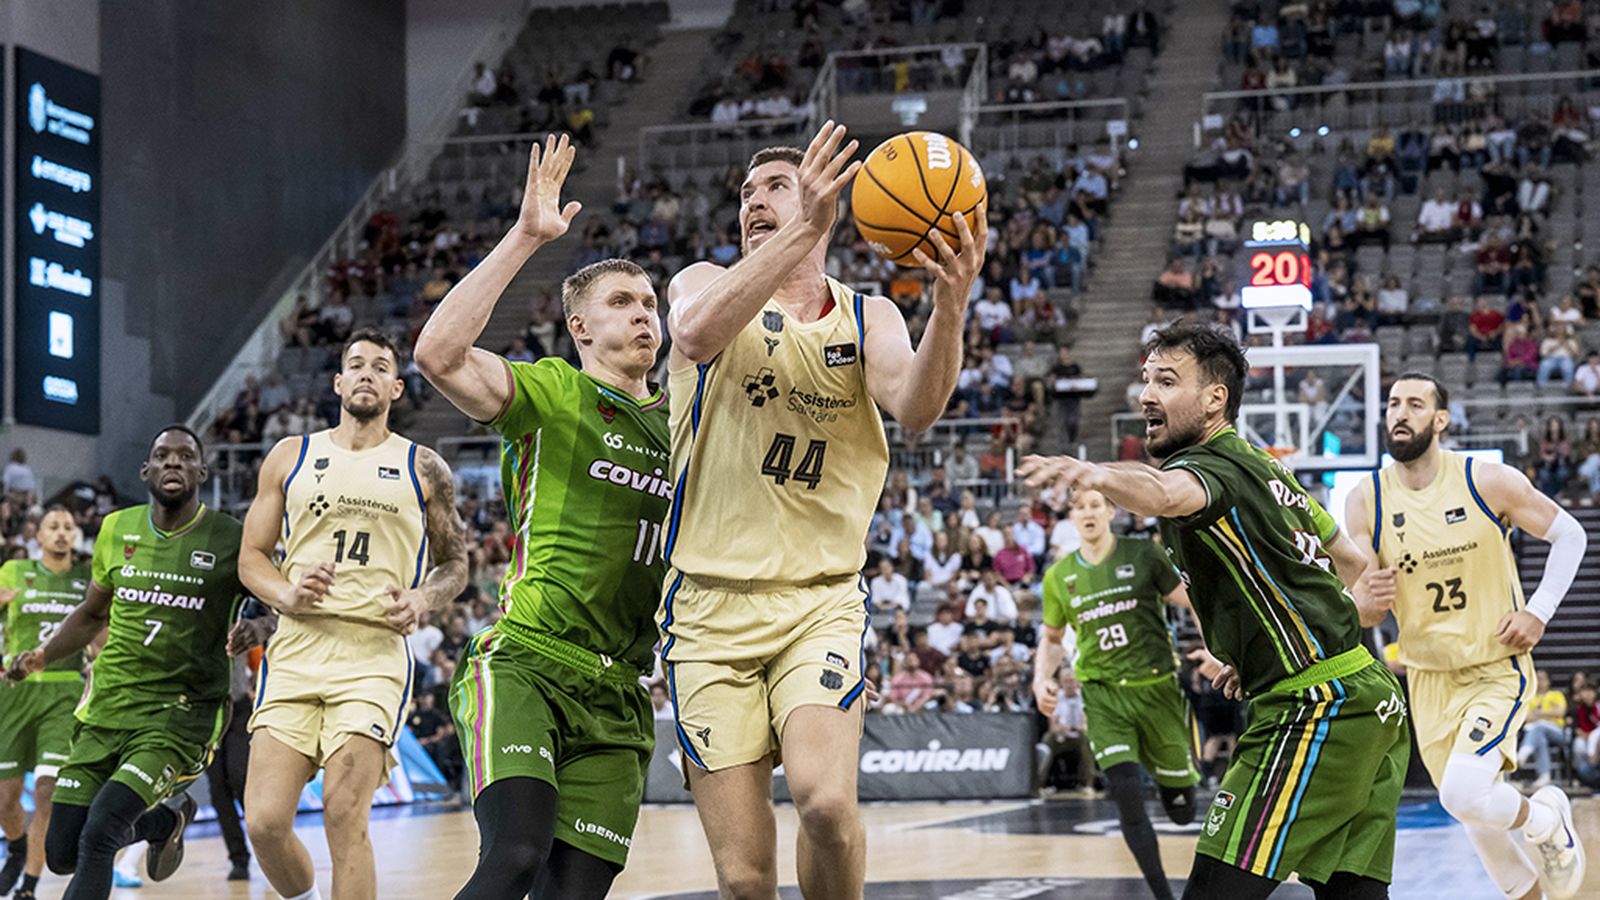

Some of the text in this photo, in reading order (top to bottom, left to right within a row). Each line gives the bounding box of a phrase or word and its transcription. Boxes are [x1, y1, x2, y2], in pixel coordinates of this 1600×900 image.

[1250, 251, 1299, 287] 20
[603, 432, 624, 449] 65
[761, 432, 827, 490] 44
[333, 530, 370, 566] 14
[633, 518, 660, 566] 11
[1425, 577, 1467, 613] 23
[143, 619, 163, 646] 7
[1095, 623, 1129, 651] 29
